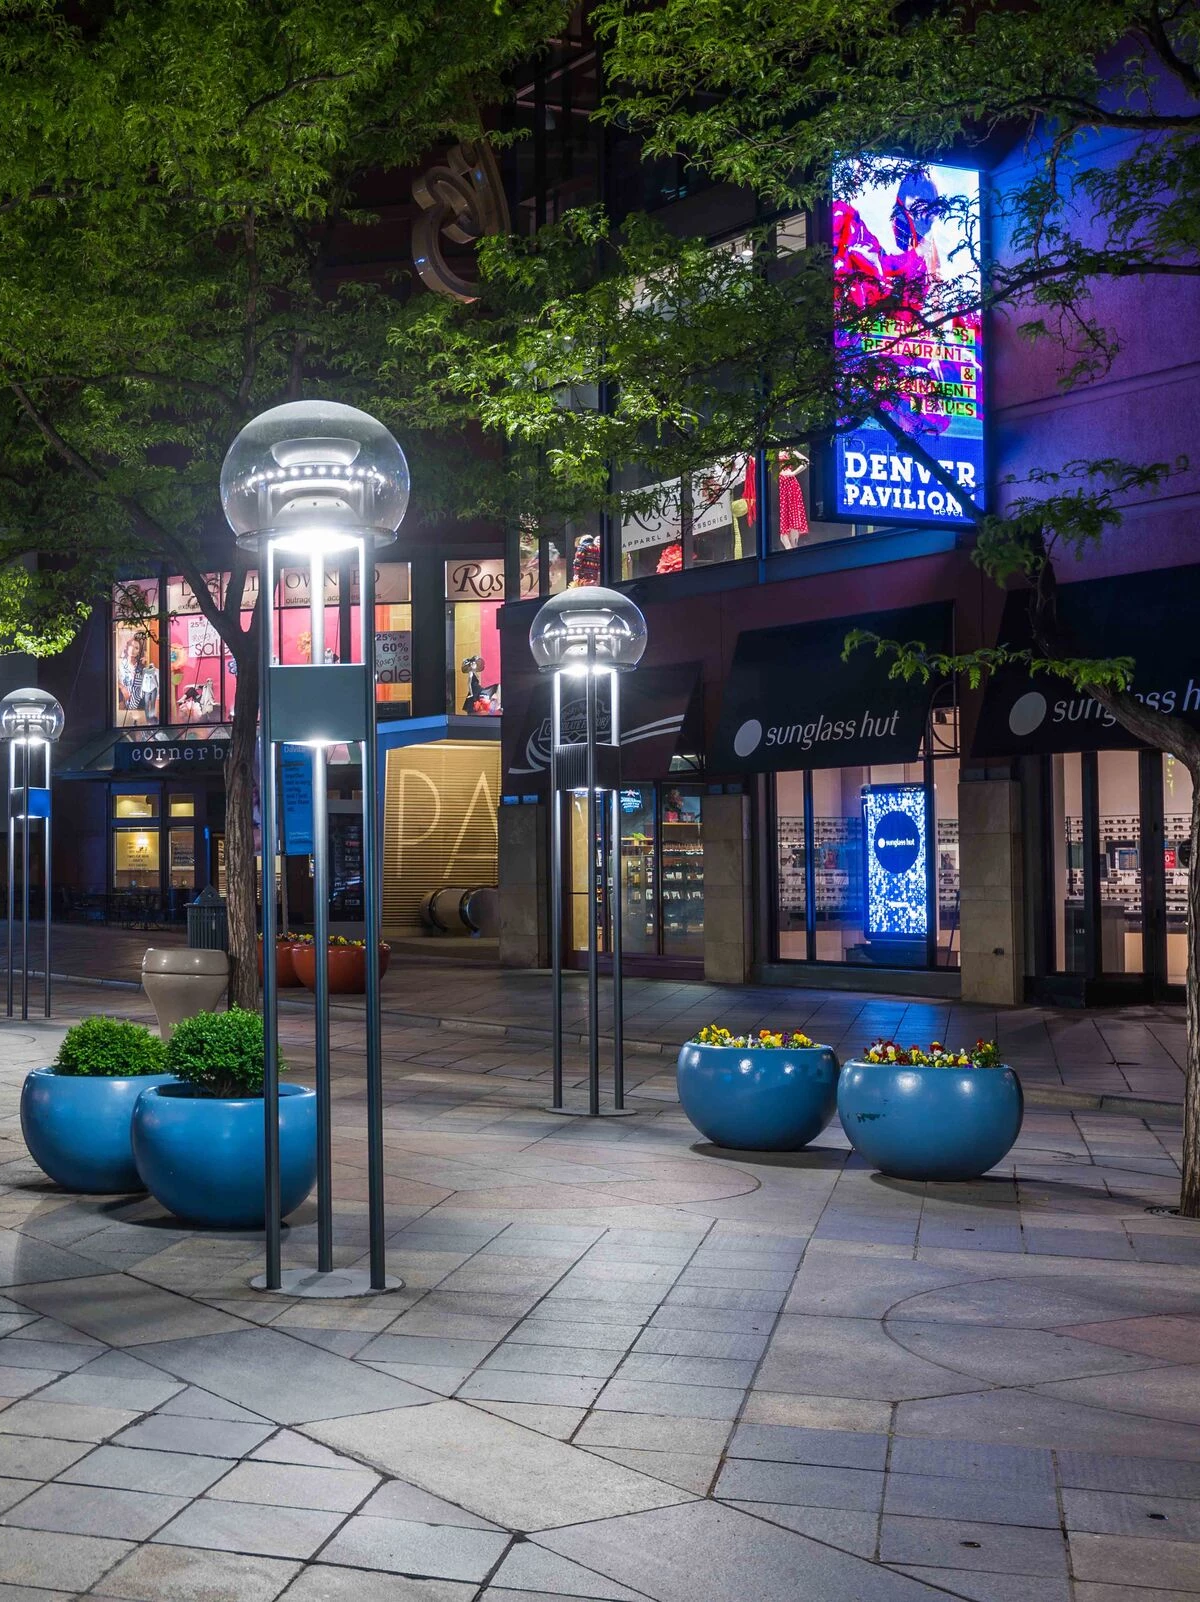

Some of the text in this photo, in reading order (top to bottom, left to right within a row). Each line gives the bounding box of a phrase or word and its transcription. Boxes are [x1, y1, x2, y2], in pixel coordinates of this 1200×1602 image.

[963, 368, 973, 380] &
[911, 399, 974, 416] ENUES
[844, 484, 976, 514] PAVILION
[622, 517, 729, 549] APPAREL & AESSORIES
[376, 633, 397, 641] 25%
[195, 639, 232, 656] sale
[382, 642, 409, 653] 60%
[1052, 685, 1177, 727] sunss
[765, 710, 900, 750] sunglass hut
[132, 746, 208, 761] corner
[886, 838, 915, 848] sunglass hut
